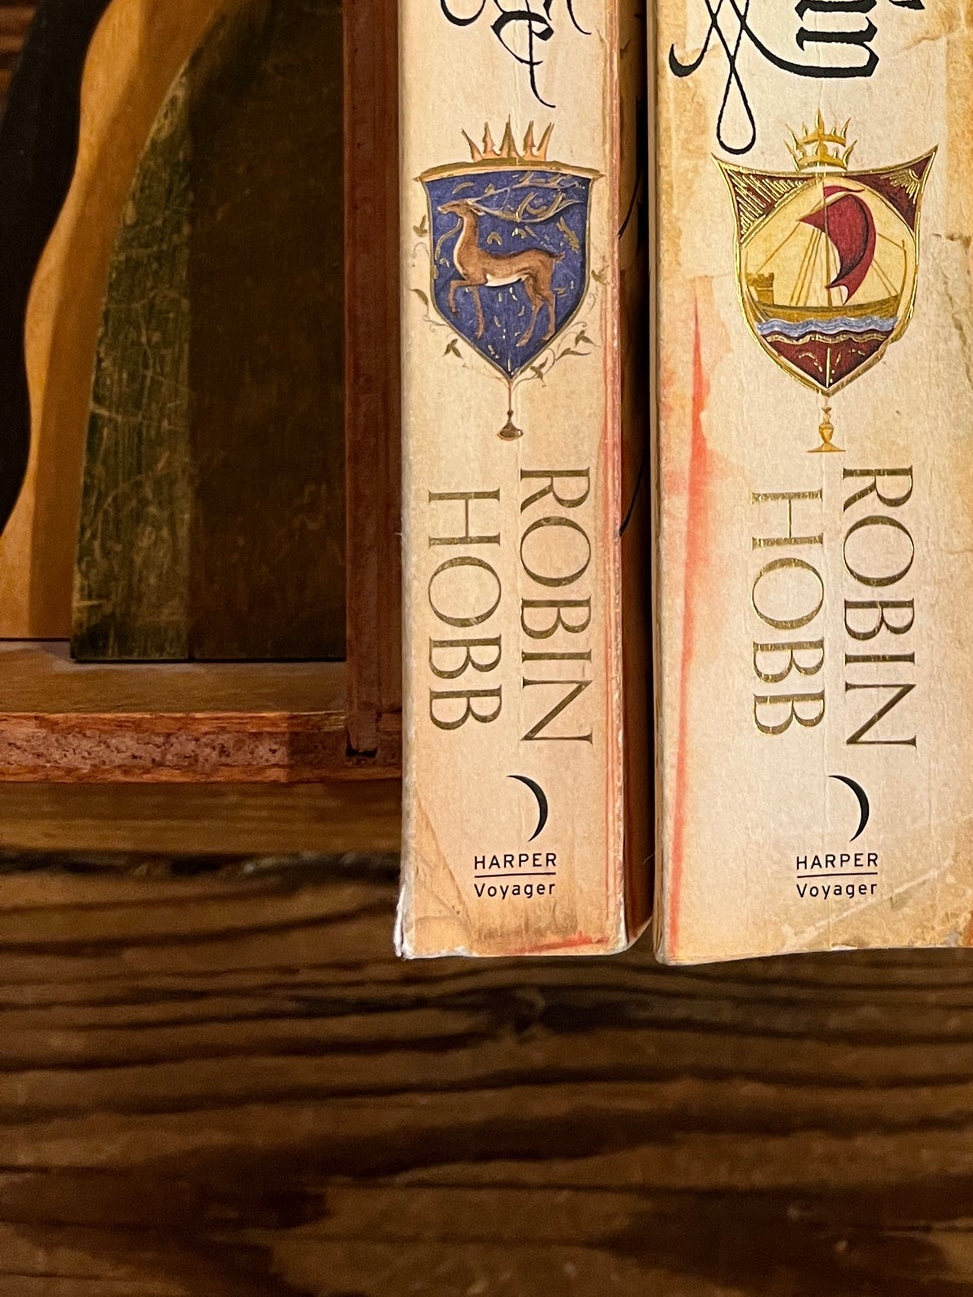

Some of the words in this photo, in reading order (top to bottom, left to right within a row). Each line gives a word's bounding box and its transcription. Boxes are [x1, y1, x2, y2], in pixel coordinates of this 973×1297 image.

[427, 488, 502, 732] HOBB
[519, 466, 594, 744] ROBIN
[751, 488, 826, 737] HOBB
[842, 465, 918, 749] ROBIN
[473, 852, 558, 870] HARPER
[473, 880, 557, 902] Voyager
[796, 852, 879, 870] HARPER
[796, 880, 878, 900] Voyager
